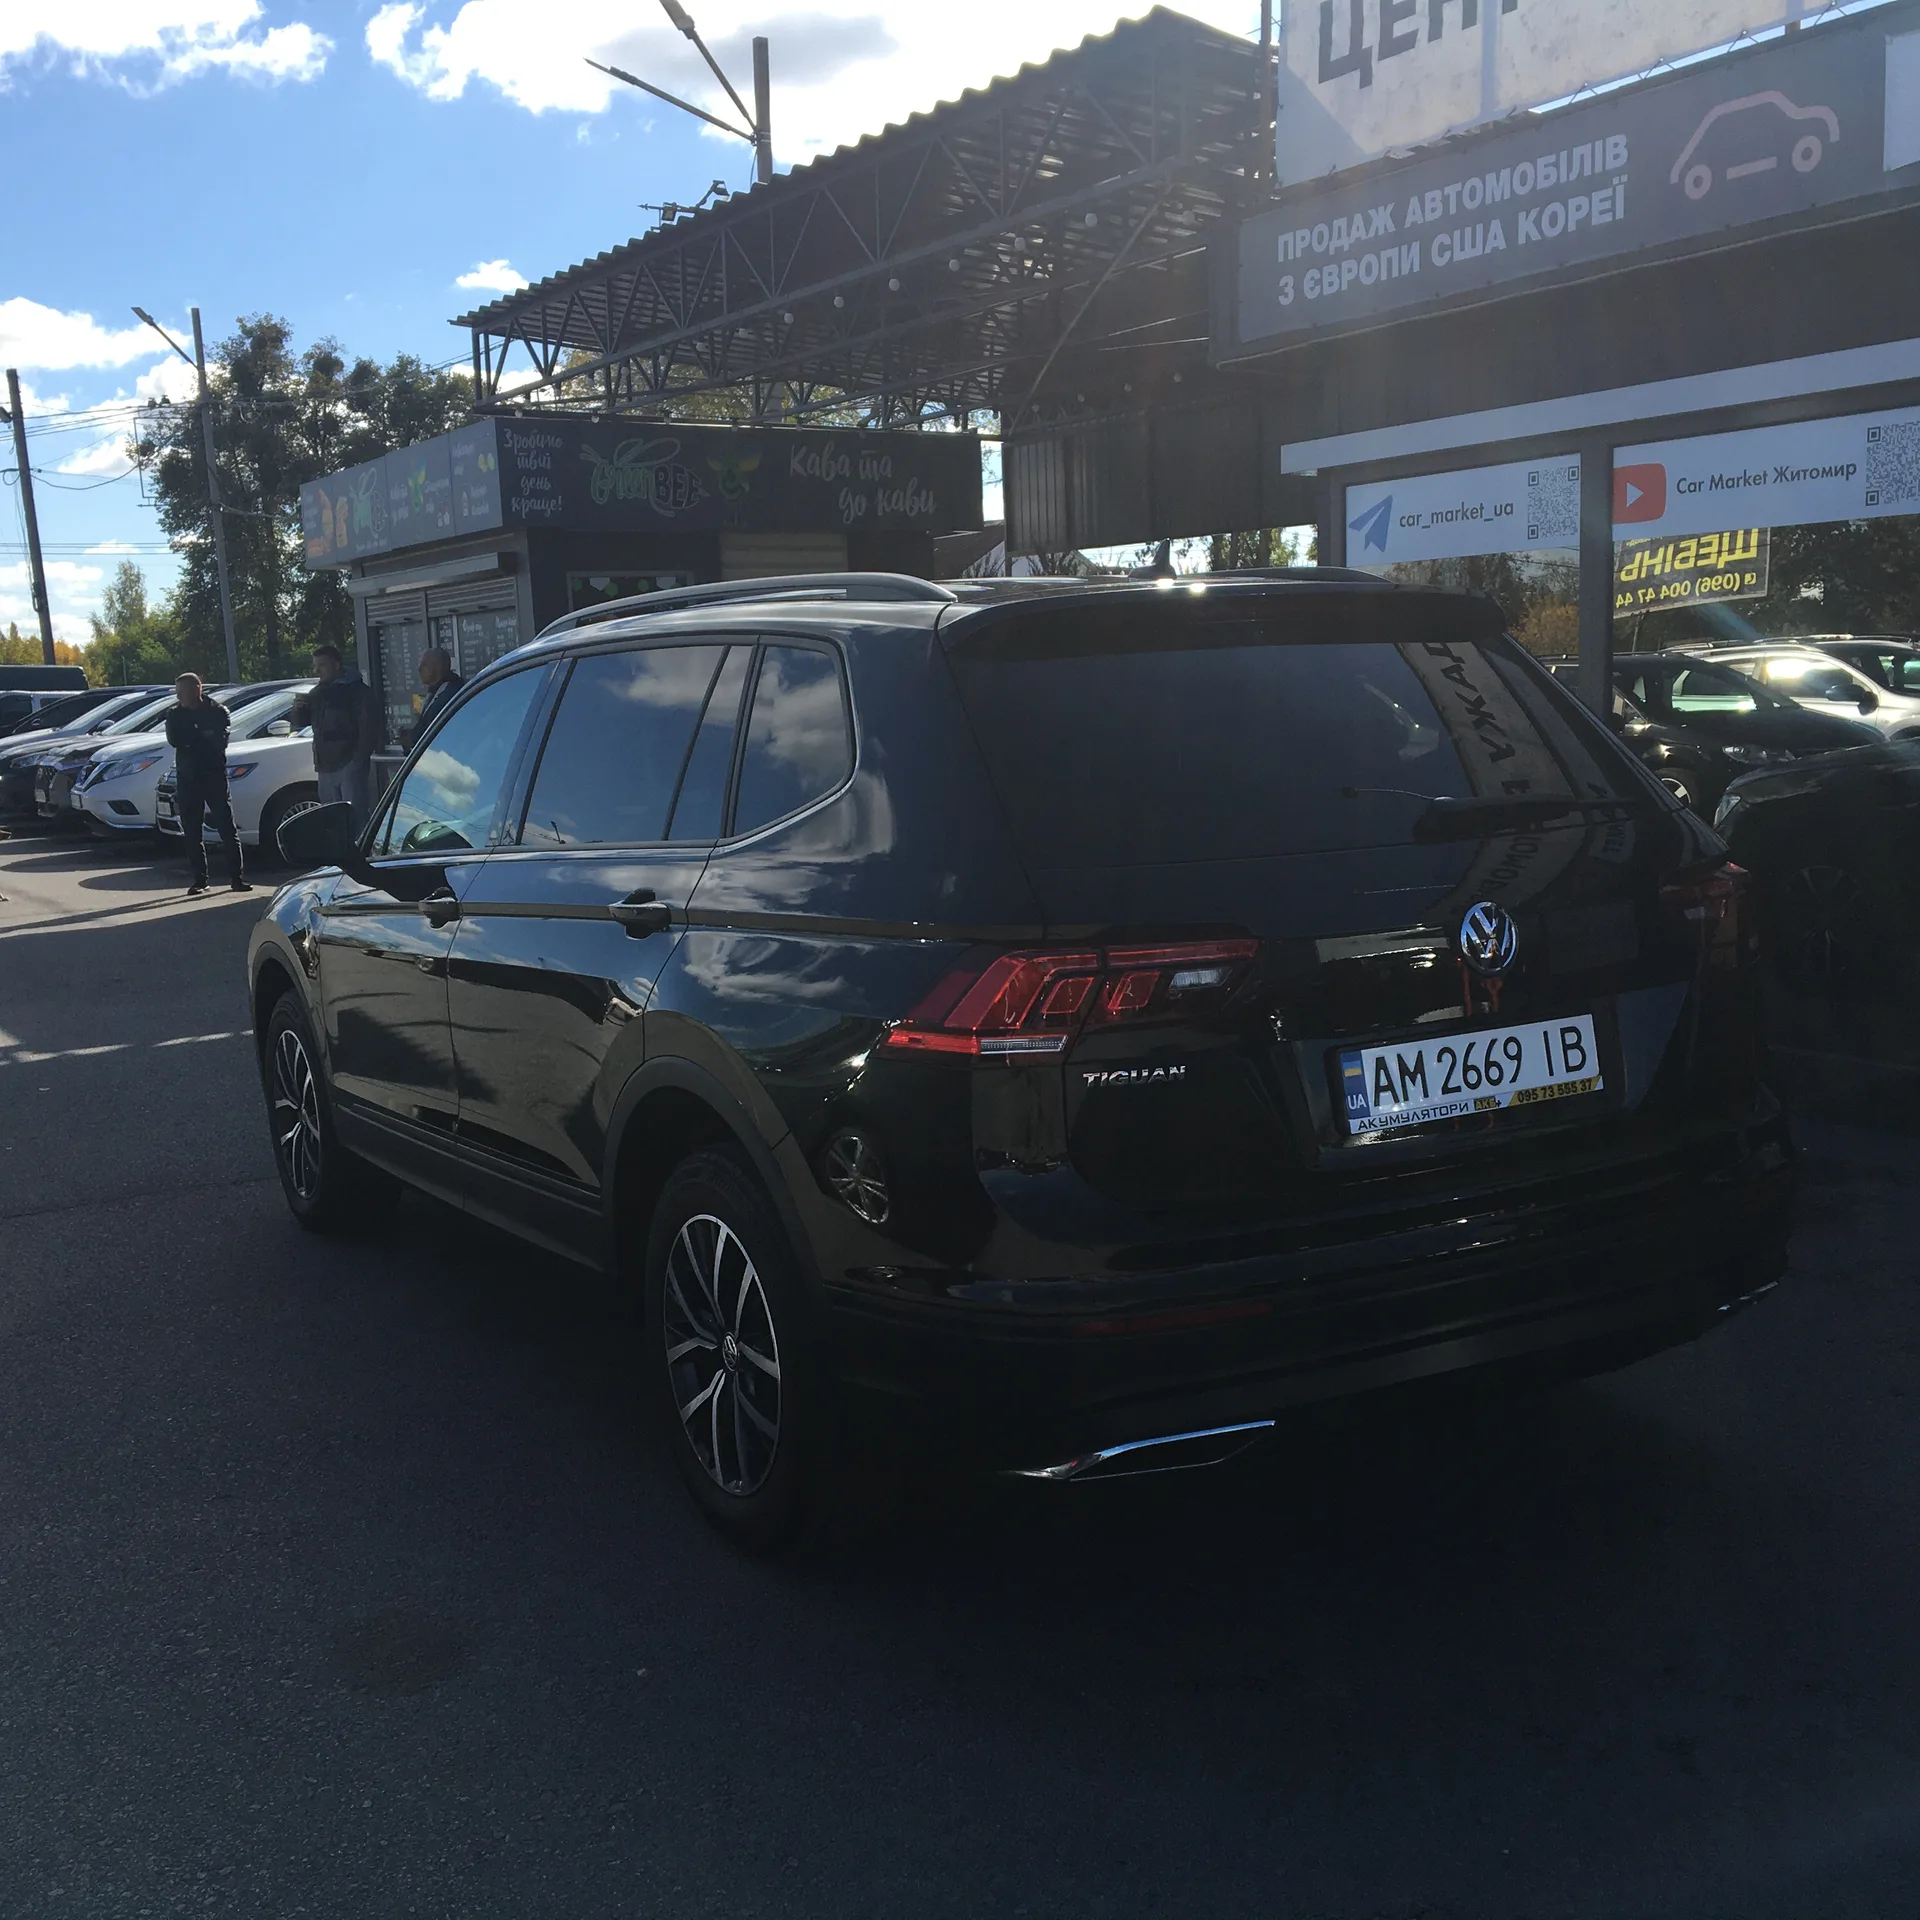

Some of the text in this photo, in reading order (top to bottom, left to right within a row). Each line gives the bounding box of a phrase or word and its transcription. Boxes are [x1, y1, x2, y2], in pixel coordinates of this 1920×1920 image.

[1278, 134, 1628, 262] ПРОДАЖ АВТОМОБІЛІВ
[1278, 174, 1629, 306] З ЄВРОПИ США КОРЕЇ
[789, 440, 895, 482] Кава та
[1676, 462, 1857, 494] Car Market Житомир
[520, 474, 552, 496] день
[838, 477, 937, 525] до кави
[511, 495, 563, 519] краще!
[1400, 501, 1514, 529] car_market_ua
[1083, 1065, 1186, 1088] TIGUAN
[1374, 1026, 1588, 1107] AM 2669 IB
[1348, 1093, 1367, 1111] UA
[1357, 1100, 1469, 1131] АКУМУЛЯТОРИ
[1517, 1090, 1539, 1103] 095
[1540, 1086, 1555, 1099] 73
[1557, 1082, 1578, 1096] 555
[1580, 1079, 1593, 1092] 37
